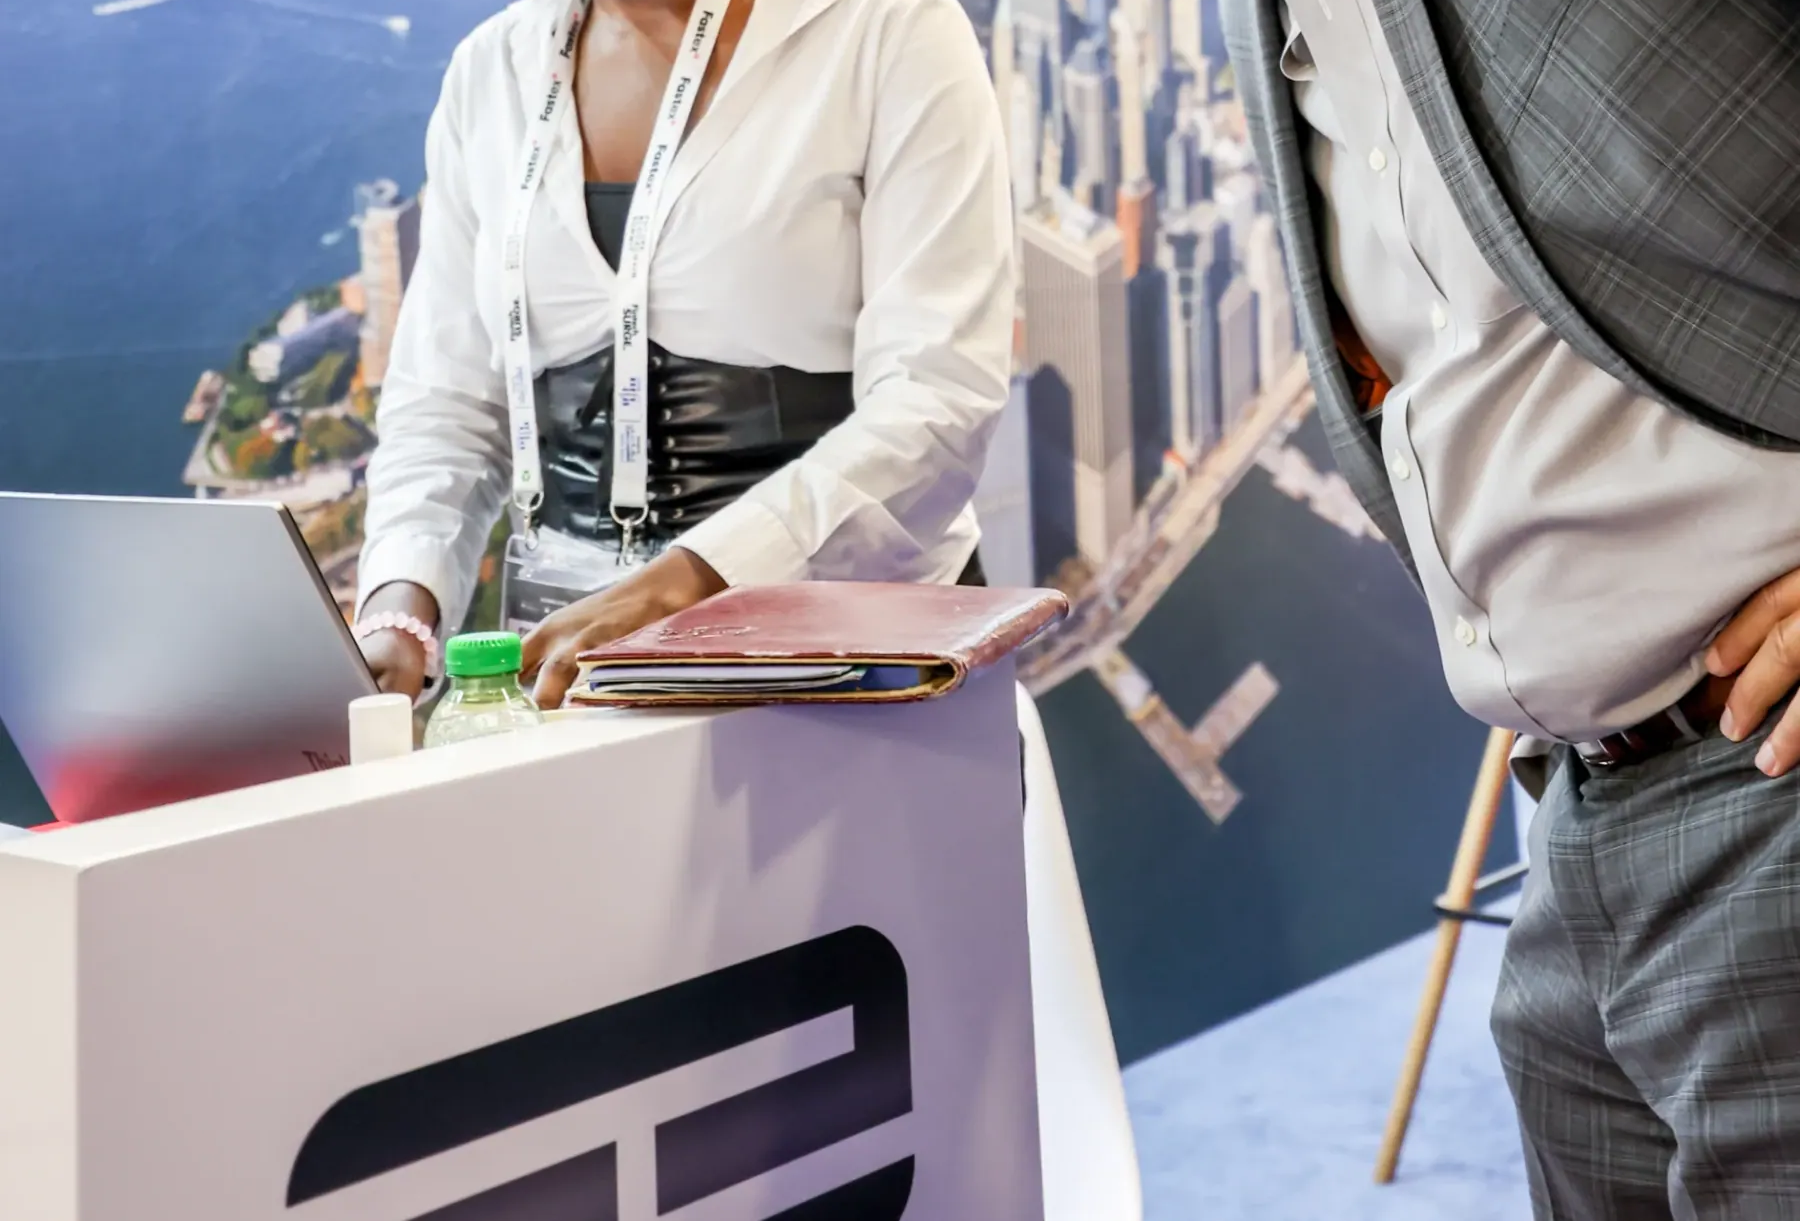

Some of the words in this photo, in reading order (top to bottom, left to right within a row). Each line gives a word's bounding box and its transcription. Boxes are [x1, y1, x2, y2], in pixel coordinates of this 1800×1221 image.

[690, 10, 714, 53] Fastex
[539, 80, 562, 122] Fastex
[667, 76, 691, 120] Fastex
[520, 146, 540, 190] Fastex
[646, 143, 668, 189] Fastex
